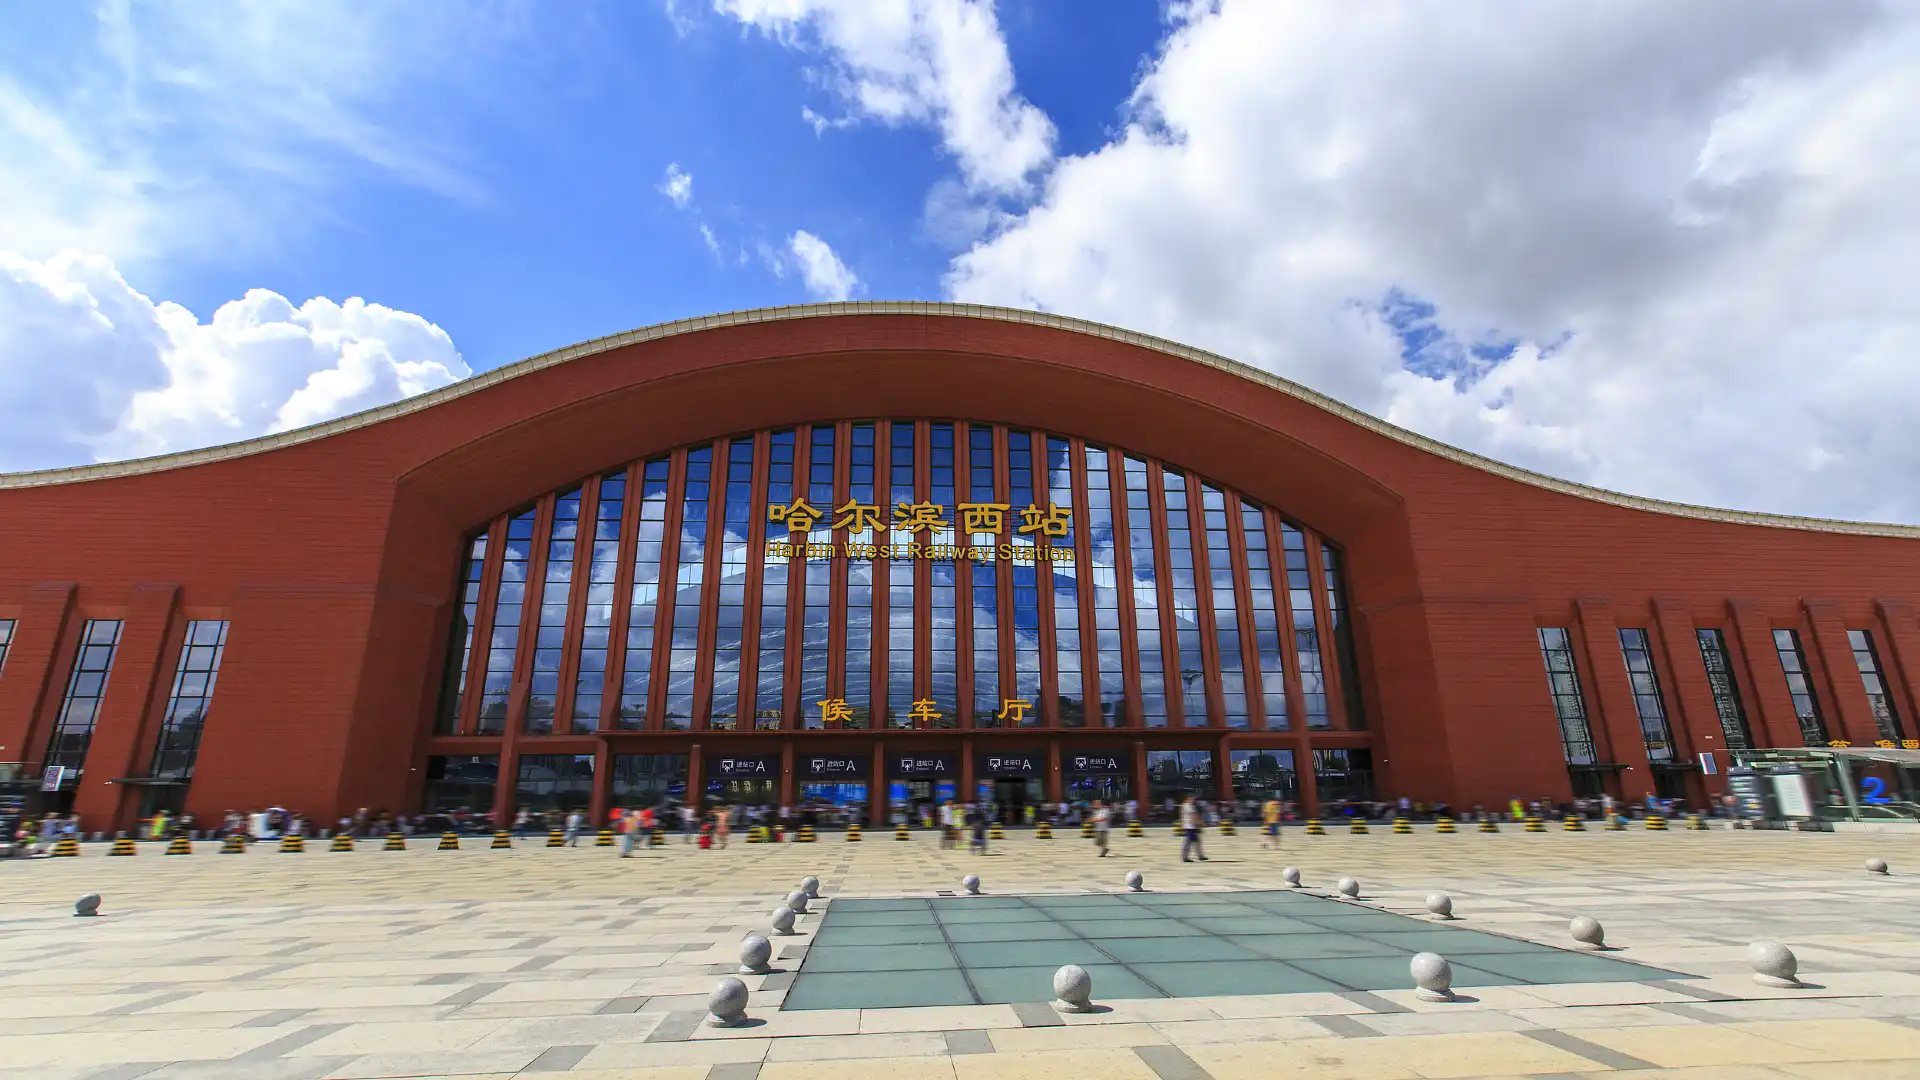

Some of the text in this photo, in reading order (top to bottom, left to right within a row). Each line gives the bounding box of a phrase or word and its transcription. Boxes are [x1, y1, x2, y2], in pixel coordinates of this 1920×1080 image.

[769, 497, 1072, 536] 哈尔滨西站
[765, 541, 1075, 564] Harbin West Railway Station
[816, 698, 1033, 722] 候车厅
[755, 760, 766, 772] A
[826, 760, 856, 771] 进站口 A
[935, 759, 945, 771] A
[1022, 759, 1032, 770] A
[1107, 758, 1117, 769] A
[1861, 777, 1891, 804] 2
